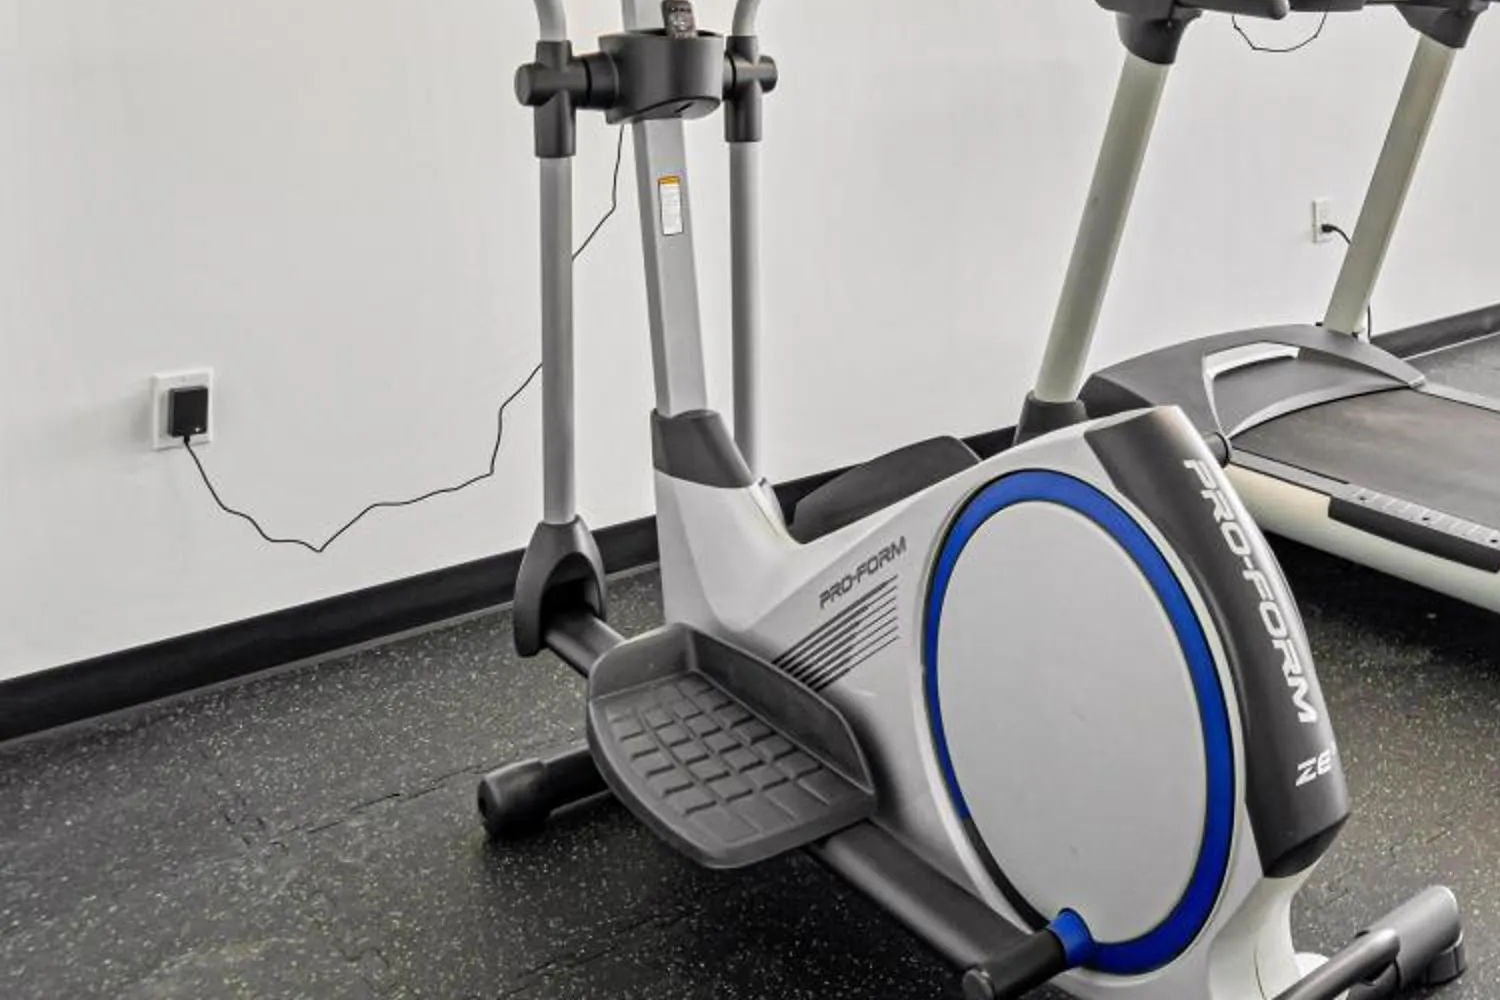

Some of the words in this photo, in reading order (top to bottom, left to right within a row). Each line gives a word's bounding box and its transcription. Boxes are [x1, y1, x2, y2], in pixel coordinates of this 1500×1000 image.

[819, 535, 907, 609] PRO-FORM
[1184, 459, 1318, 723] PRO-FORM
[1295, 741, 1337, 787] ZE
